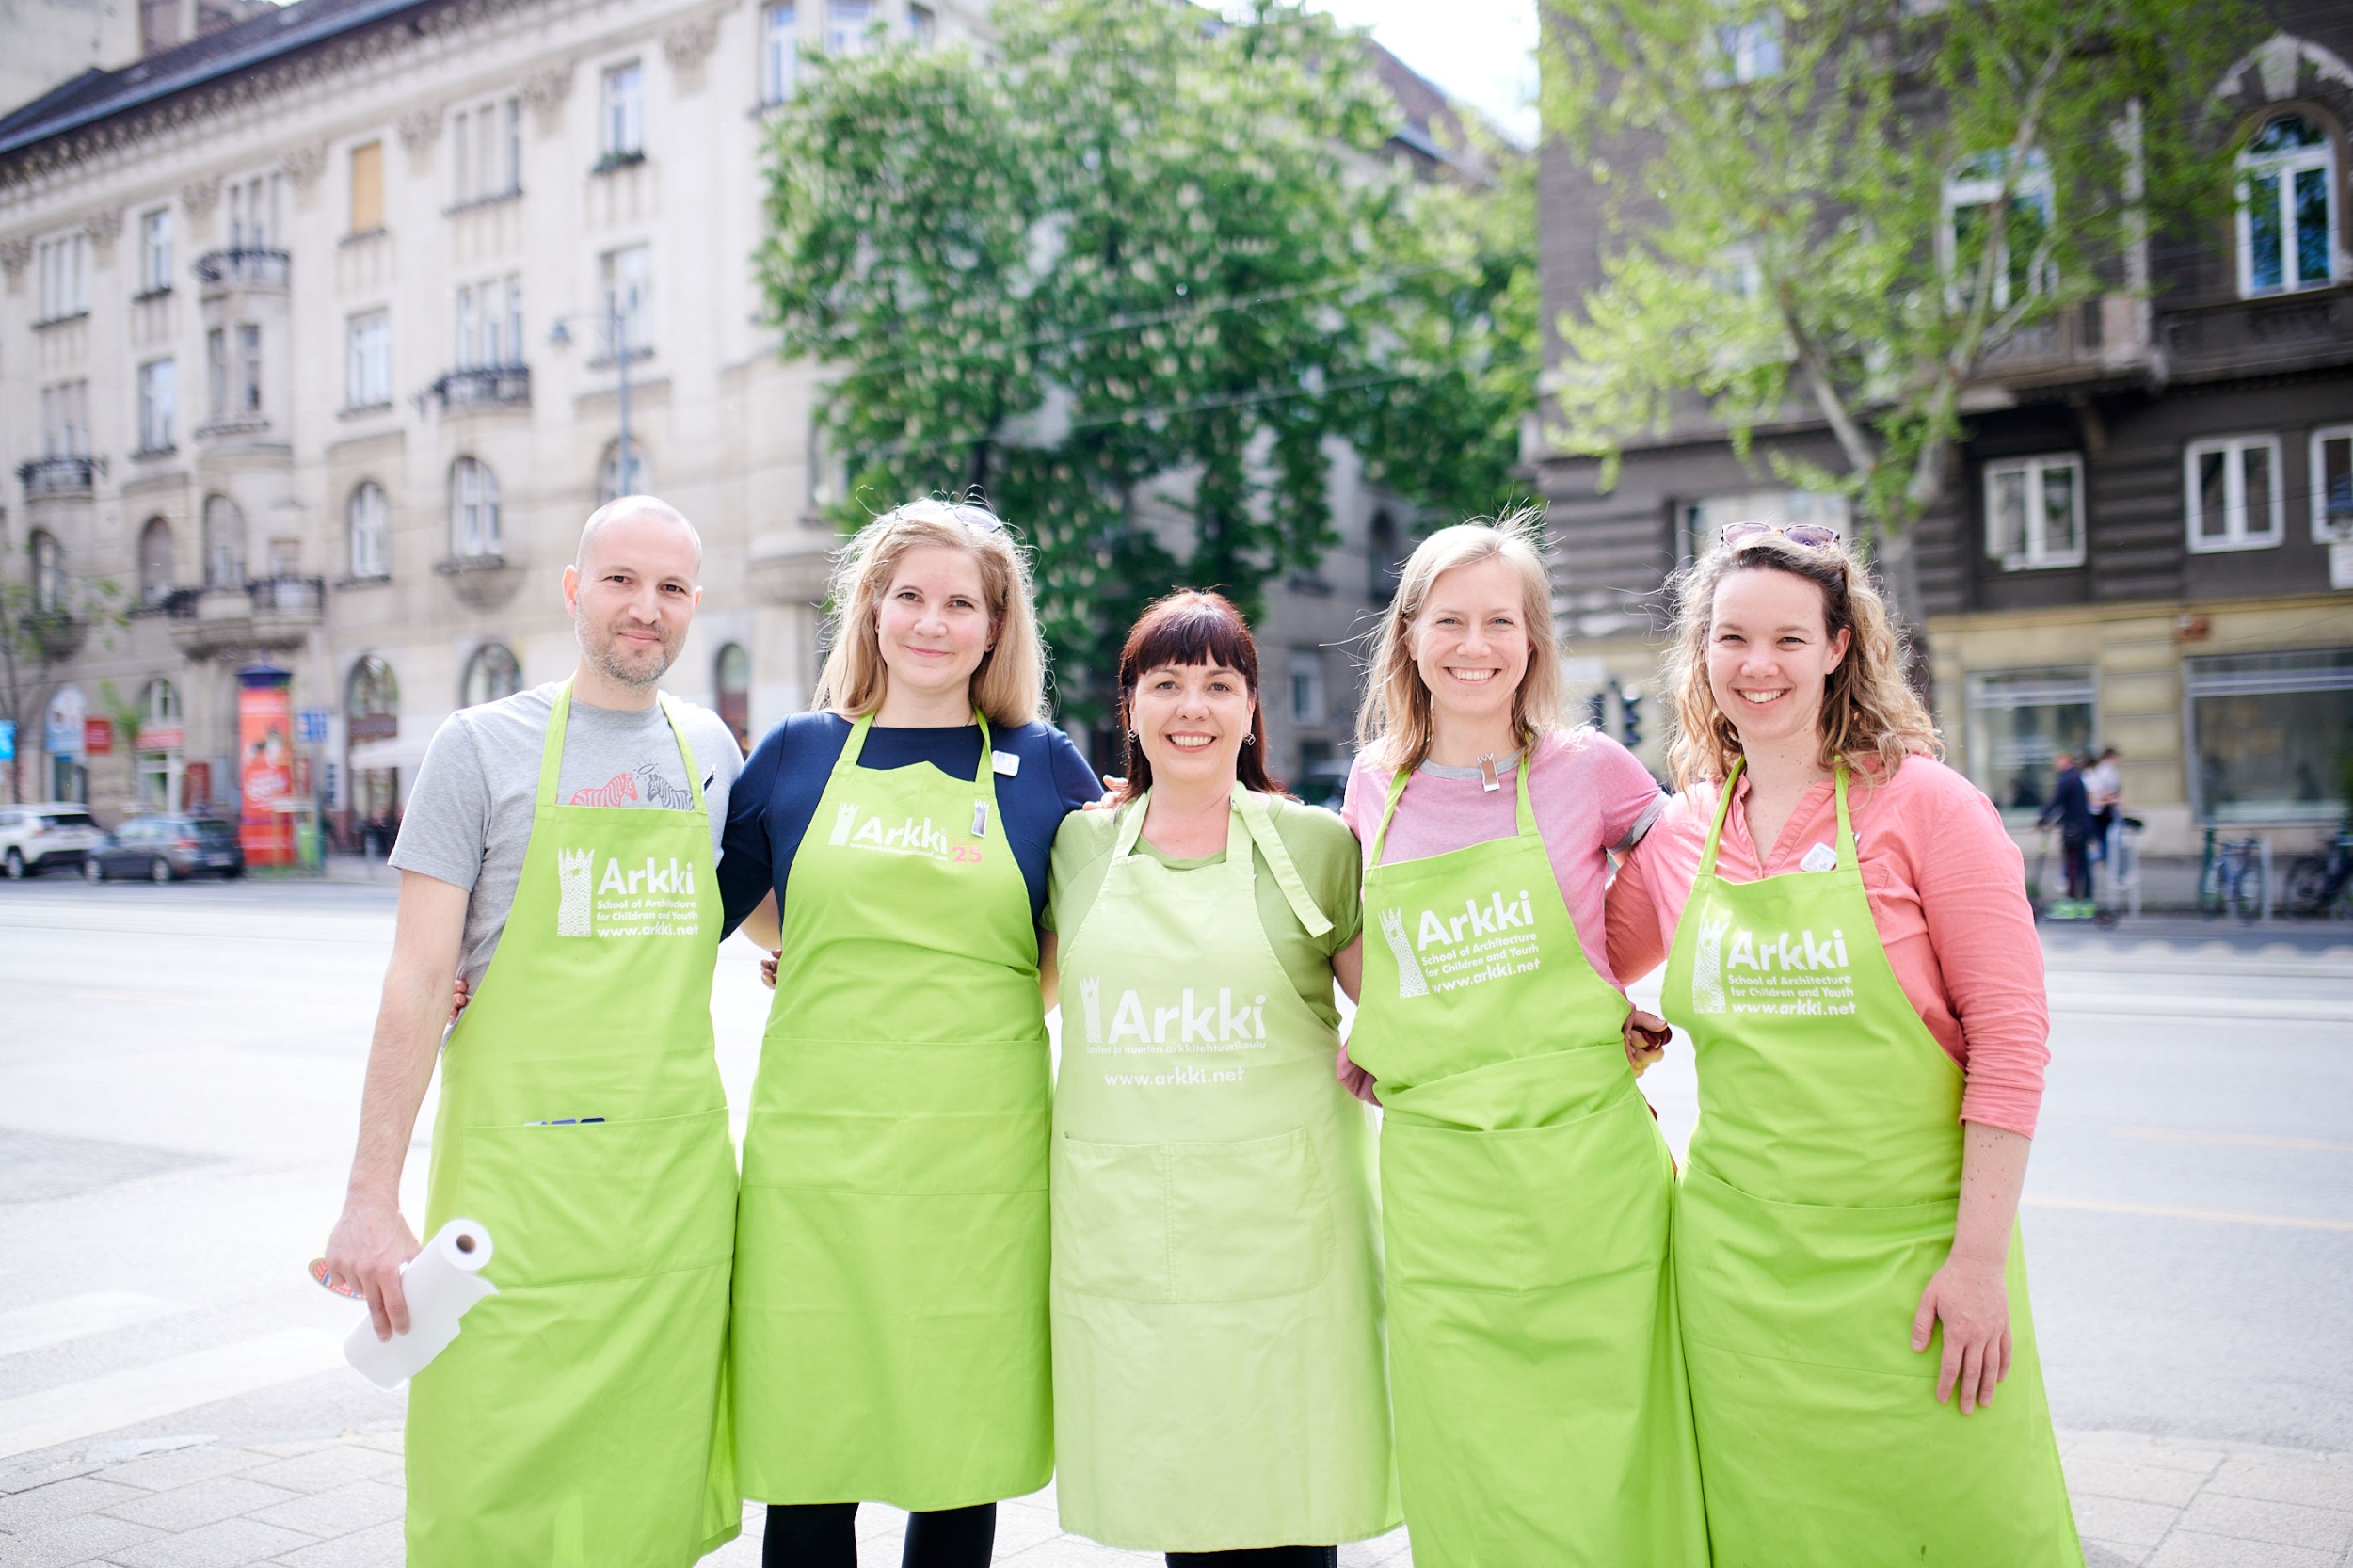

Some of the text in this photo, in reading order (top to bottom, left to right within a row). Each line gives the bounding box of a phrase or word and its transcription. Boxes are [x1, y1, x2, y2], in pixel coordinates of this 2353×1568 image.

[853, 816, 948, 854] Arkki
[952, 846, 983, 864] 25
[597, 857, 696, 894] Arkki
[597, 900, 628, 910] School
[631, 899, 642, 908] of
[597, 910, 698, 921] for Children and Youth
[1417, 889, 1534, 952] Arkki
[597, 921, 699, 937] www.arkki.net
[1421, 933, 1538, 967] School of Architecture
[1726, 928, 1849, 971] Arkki
[1425, 943, 1540, 978] for Children and Youth
[1432, 958, 1542, 993] www.arkki.net
[1727, 974, 1852, 986] School of Architecture
[1730, 986, 1855, 999] for Children and Youth
[1108, 988, 1267, 1044] Arkki
[1732, 998, 1857, 1016] www.arkki.net
[1113, 1045, 1122, 1056] ja
[1125, 1045, 1163, 1055] nuorten
[1104, 1065, 1246, 1086] www.arkki.net
